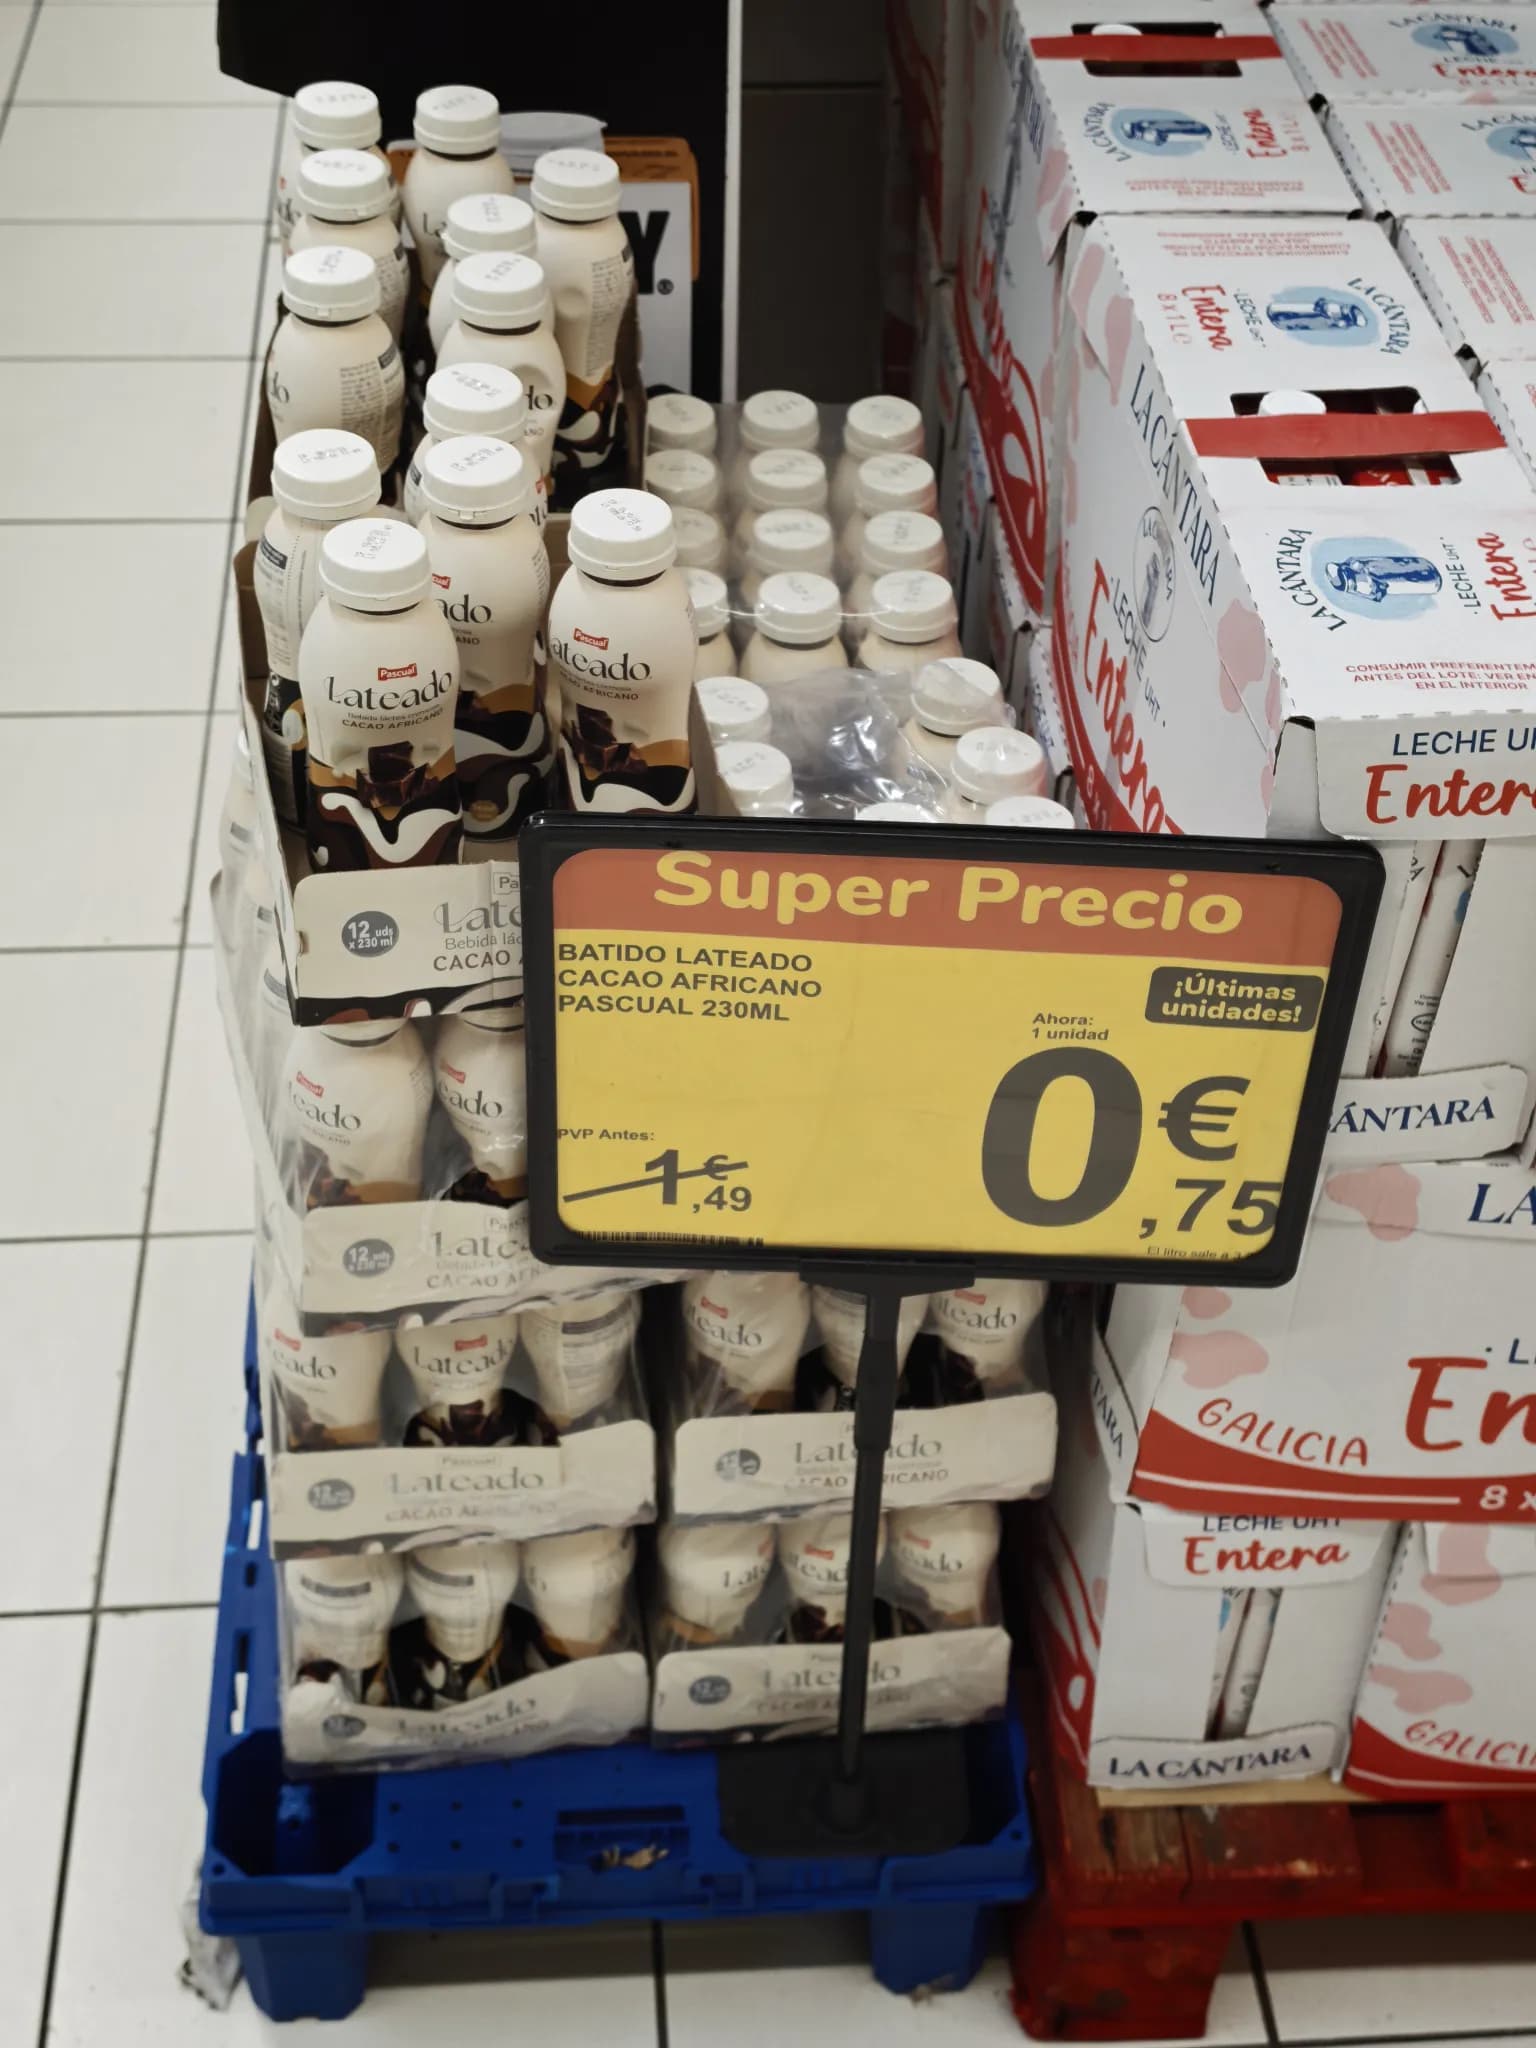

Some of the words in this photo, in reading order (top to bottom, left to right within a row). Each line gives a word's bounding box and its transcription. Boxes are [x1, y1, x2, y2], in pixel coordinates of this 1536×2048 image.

[1181, 284, 1233, 352] Entera
[1443, 544, 1461, 562] UHT
[1445, 562, 1482, 608] LECHE
[1477, 532, 1536, 621] Entera
[1112, 588, 1145, 687] LECHE
[1144, 678, 1161, 718] UHT
[379, 665, 415, 679] Pascual
[1345, 662, 1427, 673] CONSUMIR
[1353, 672, 1404, 683] ANTES
[1406, 672, 1434, 681] DEL
[1484, 672, 1514, 681] VER
[323, 669, 453, 710] Lateado
[1415, 681, 1436, 690] EN
[1438, 681, 1457, 690] EL
[1460, 681, 1528, 691] INTERIOR
[342, 719, 384, 730] CACAO
[1393, 729, 1497, 756] LECHE
[1366, 763, 1536, 825] Enter
[653, 850, 930, 926] Super
[958, 866, 1243, 935] Precio
[348, 920, 371, 940] 12
[375, 926, 394, 938] uds
[358, 937, 378, 949] 230
[380, 936, 393, 948] ml
[445, 933, 498, 951] Bebida
[433, 950, 511, 971] CACAO
[558, 943, 666, 963] BATIDO
[676, 947, 812, 972] LATEADO
[558, 969, 663, 989] CACAO
[670, 972, 822, 998] AFRICANO
[1174, 972, 1296, 1002] ¡Últimas
[558, 994, 693, 1016] PASCUAL
[701, 999, 790, 1022] 230ML
[1033, 1012, 1094, 1026] Ahora:
[1161, 1000, 1303, 1024] unidades!
[1031, 1028, 1040, 1040] 1
[1047, 1028, 1109, 1041] unidad
[557, 1128, 594, 1140] PVP
[599, 1129, 655, 1141] Antes:
[981, 1046, 1143, 1228] 0
[1163, 1247, 1187, 1258] litro
[1197, 1397, 1369, 1468] GALICIA
[1480, 1484, 1508, 1510] 8
[1203, 1515, 1285, 1532] LECHE
[1183, 1536, 1349, 1575] Entera
